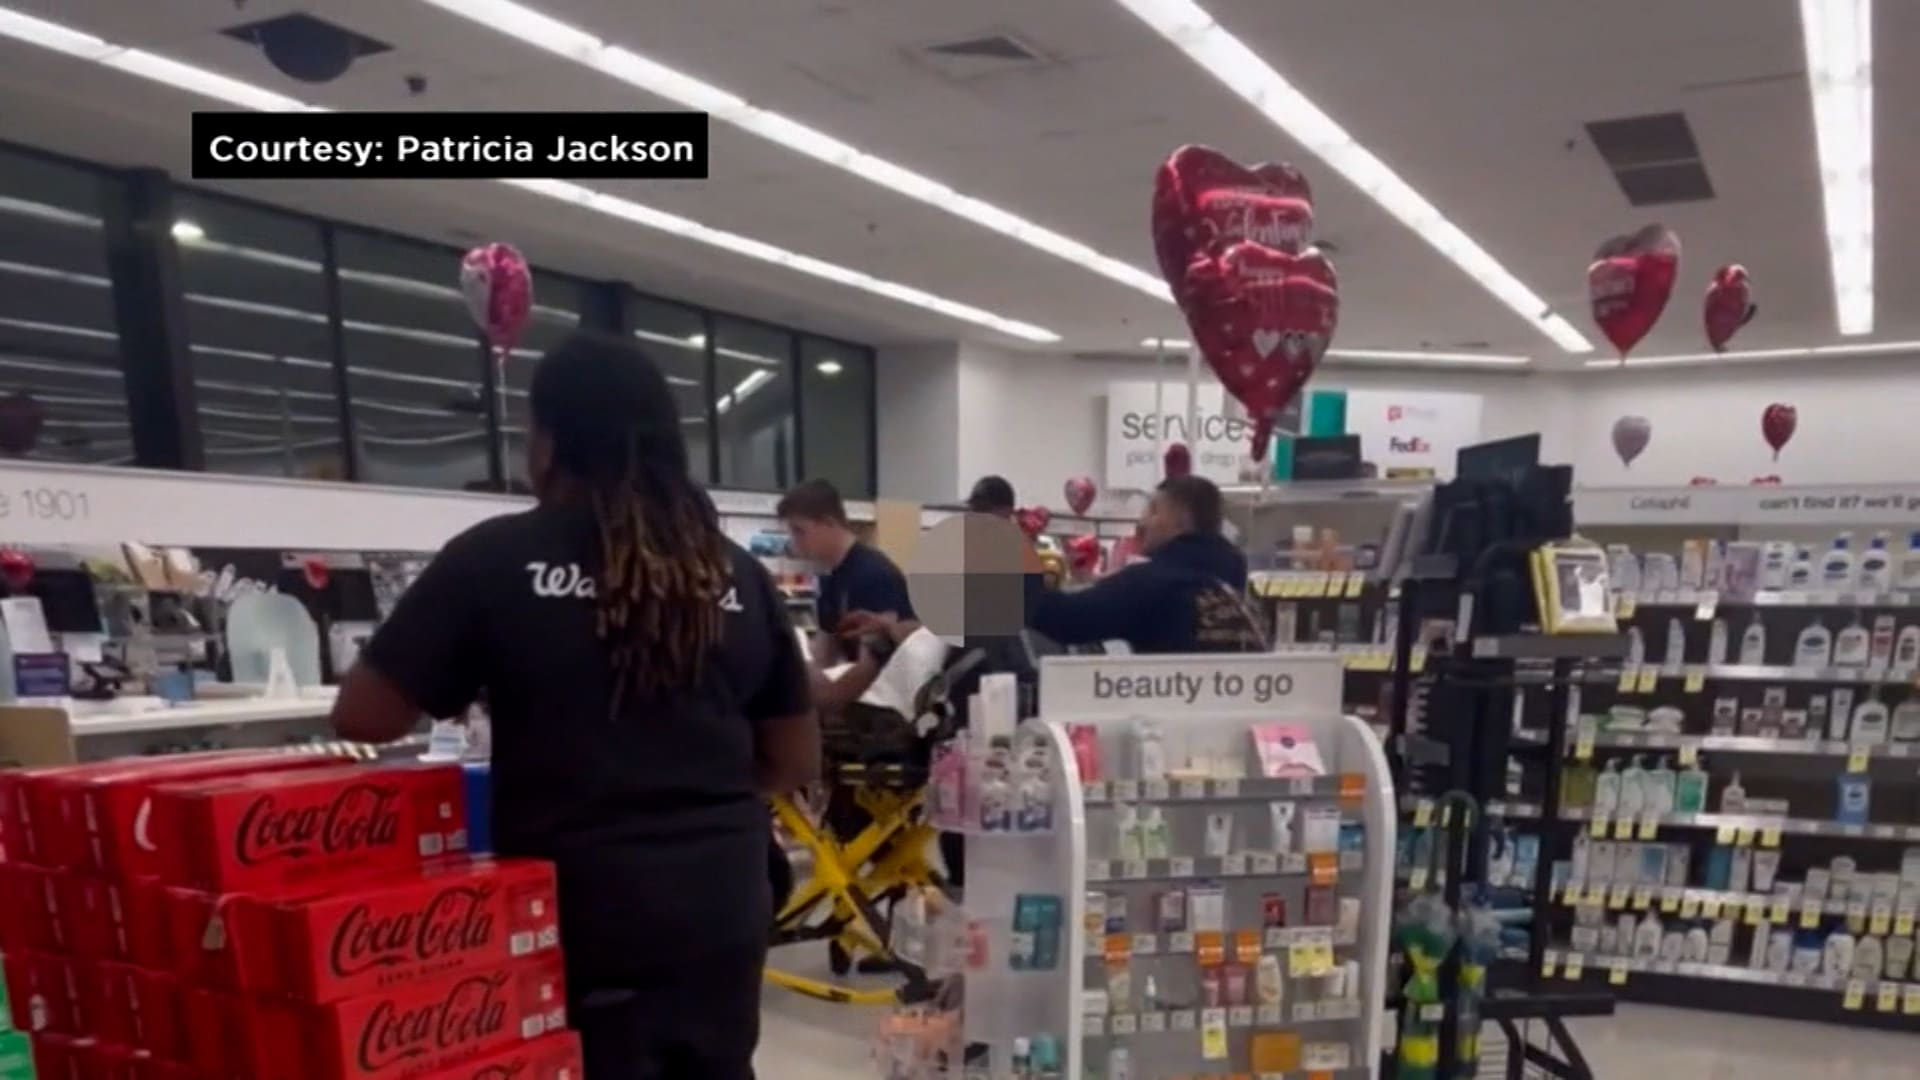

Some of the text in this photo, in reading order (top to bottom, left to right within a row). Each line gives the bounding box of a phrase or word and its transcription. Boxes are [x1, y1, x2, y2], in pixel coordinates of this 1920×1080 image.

[22, 488, 89, 520] 1901
[1094, 671, 1293, 704] beauty to go
